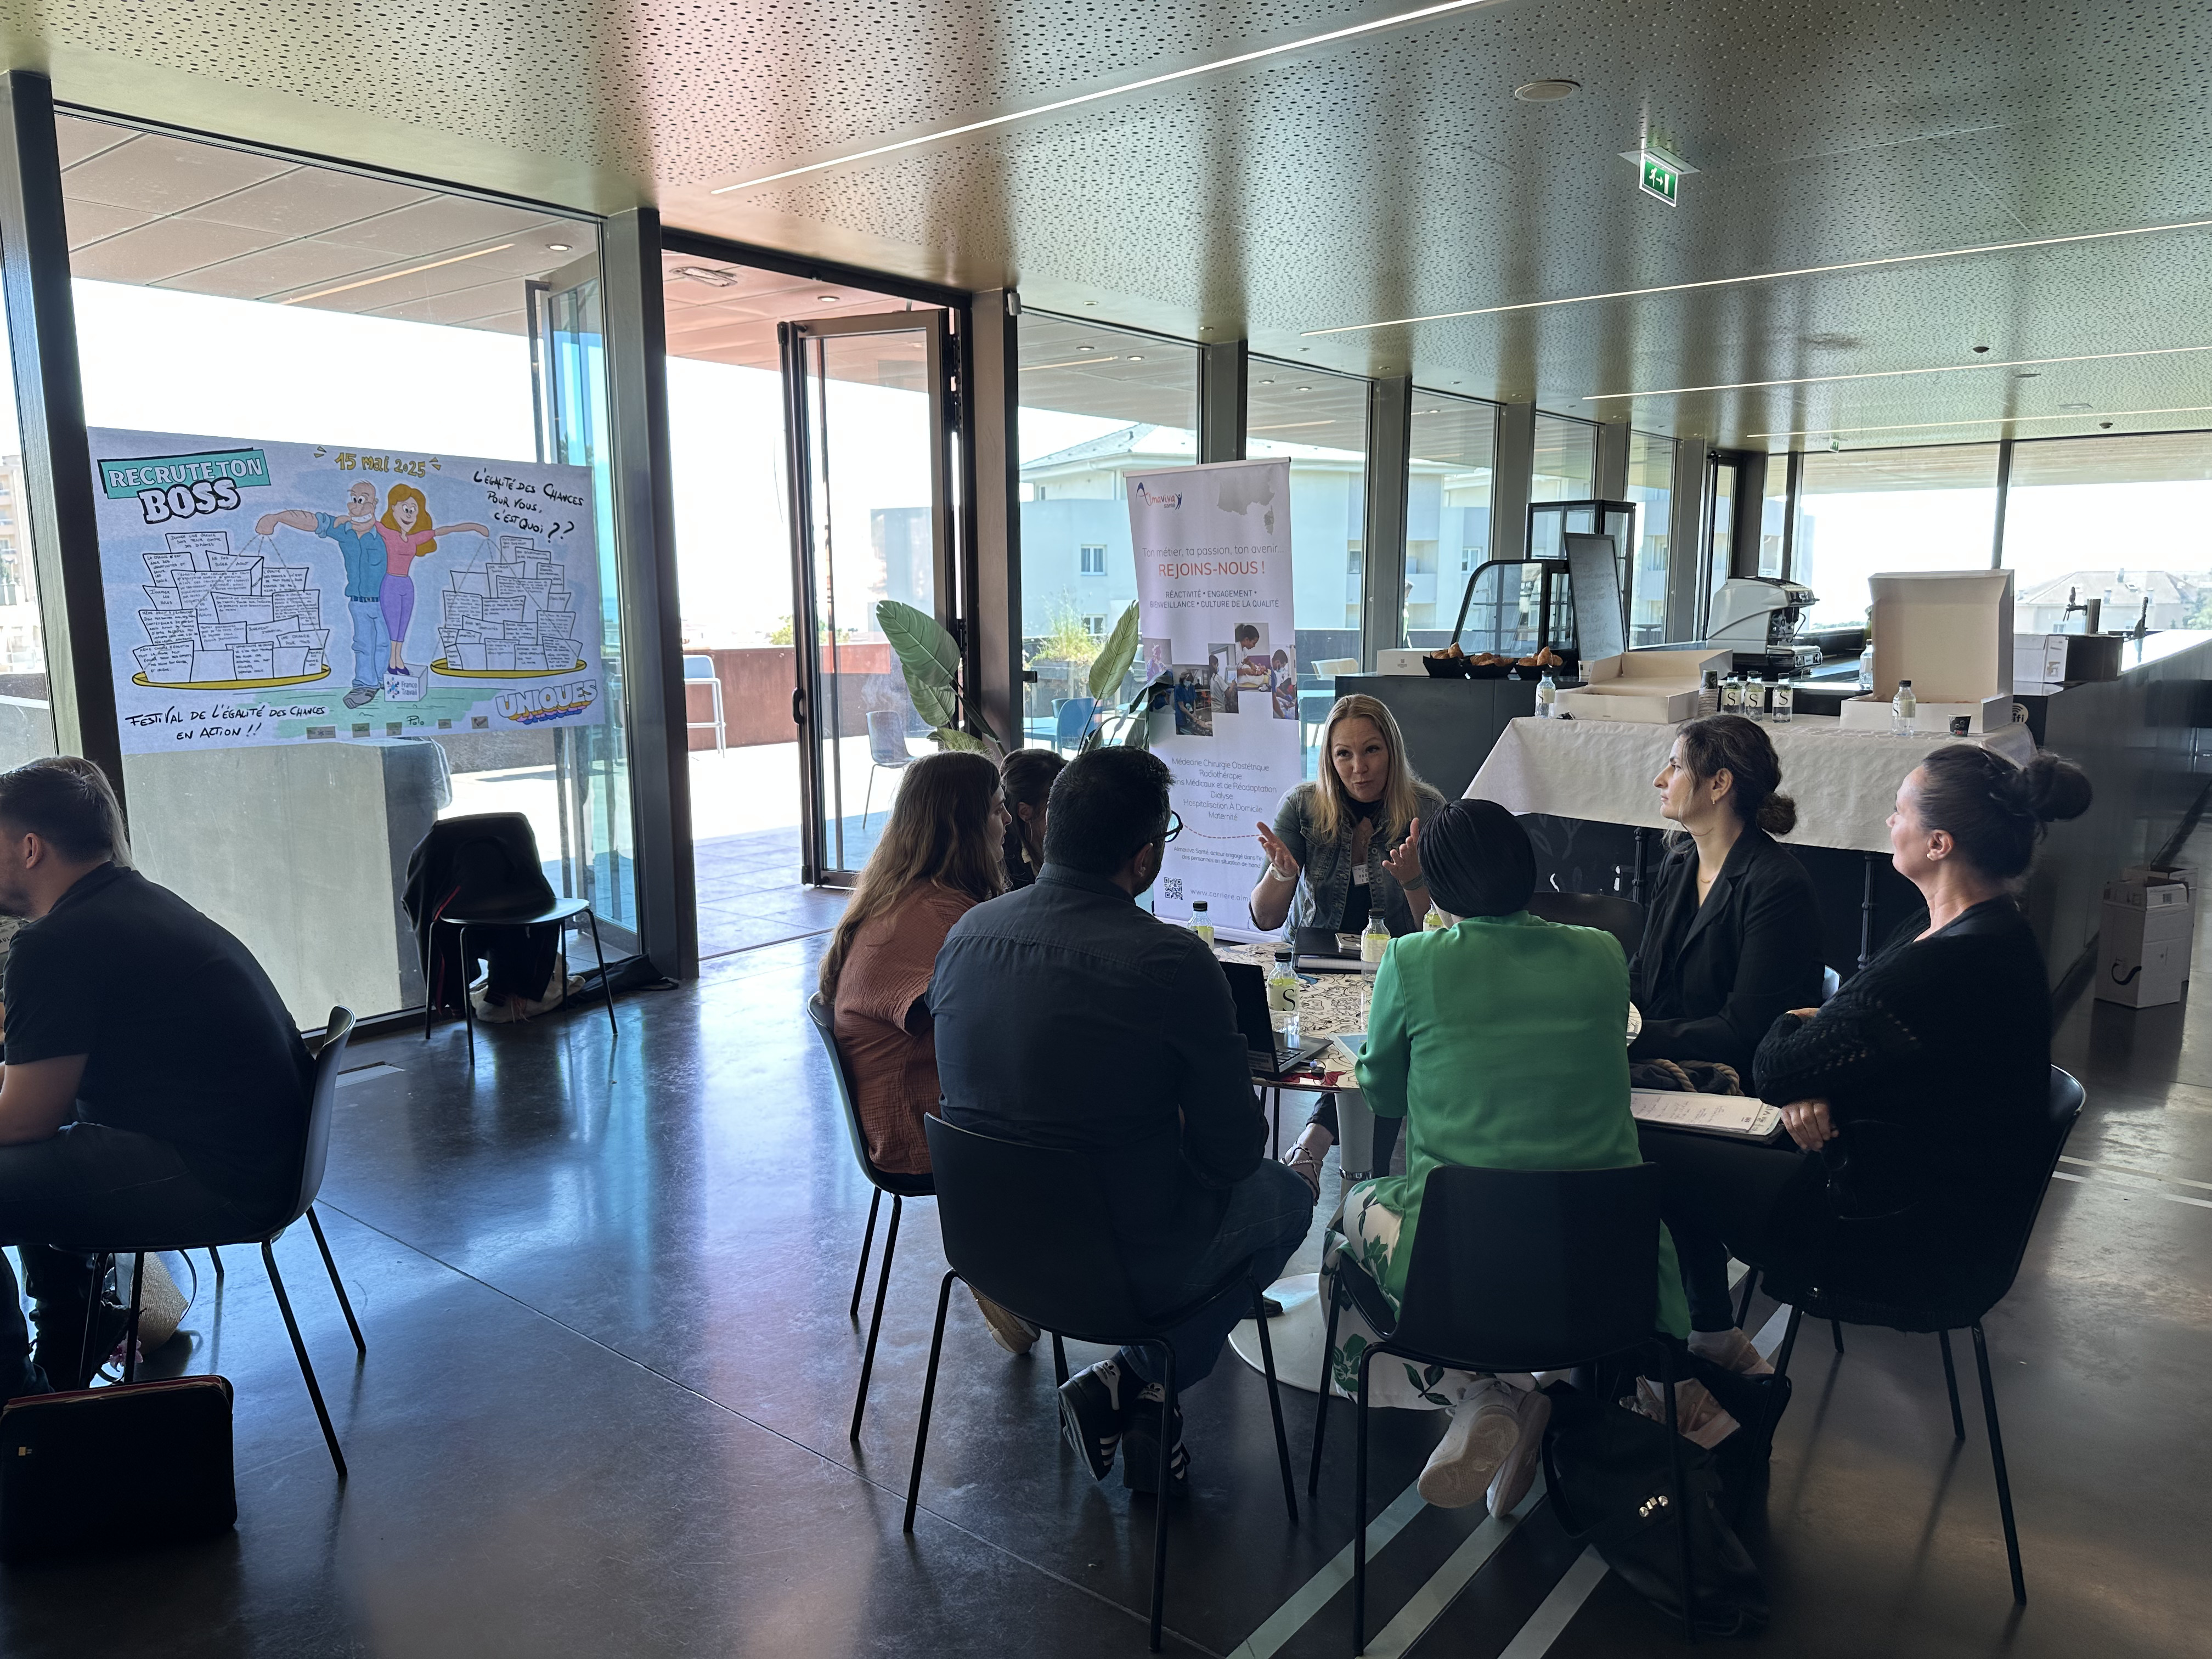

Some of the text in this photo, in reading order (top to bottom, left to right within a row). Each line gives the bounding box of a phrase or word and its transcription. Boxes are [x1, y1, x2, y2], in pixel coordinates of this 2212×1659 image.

[335, 452, 426, 478] 15 mai 2025
[108, 458, 264, 488] RECRUTE TON
[138, 477, 241, 524] BOSS
[487, 490, 510, 508] POUR
[516, 482, 535, 493] DES
[543, 483, 584, 506] CHANCES
[1142, 548, 1155, 557] Ton
[1156, 546, 1184, 557] métier,
[1186, 547, 1194, 556] ta
[1197, 546, 1232, 557] passion,
[1234, 545, 1249, 554] ton
[1158, 561, 1259, 579] REJOINS-NOUS
[1165, 589, 1201, 599] RÉACTIVITÉ
[1252, 599, 1279, 607] QUALITÉ
[495, 679, 598, 721] UNIQUES
[125, 706, 184, 726] FESTIVAL
[190, 710, 206, 720] DE
[269, 709, 287, 717] DES
[290, 706, 326, 715] CHANCES
[177, 731, 194, 740] EN
[200, 726, 241, 738] ACTION
[1172, 757, 1269, 772] Médecine Chirurgie Obstétrique
[1199, 769, 1242, 780] Radiothérapie
[1186, 779, 1215, 788] Médicaux
[1233, 782, 1277, 793] Réadaptation
[1210, 791, 1233, 801] Dialyse
[1183, 799, 1228, 810] Hospitalisation
[1236, 803, 1263, 812] Domicile
[1208, 811, 1238, 821] Maternité
